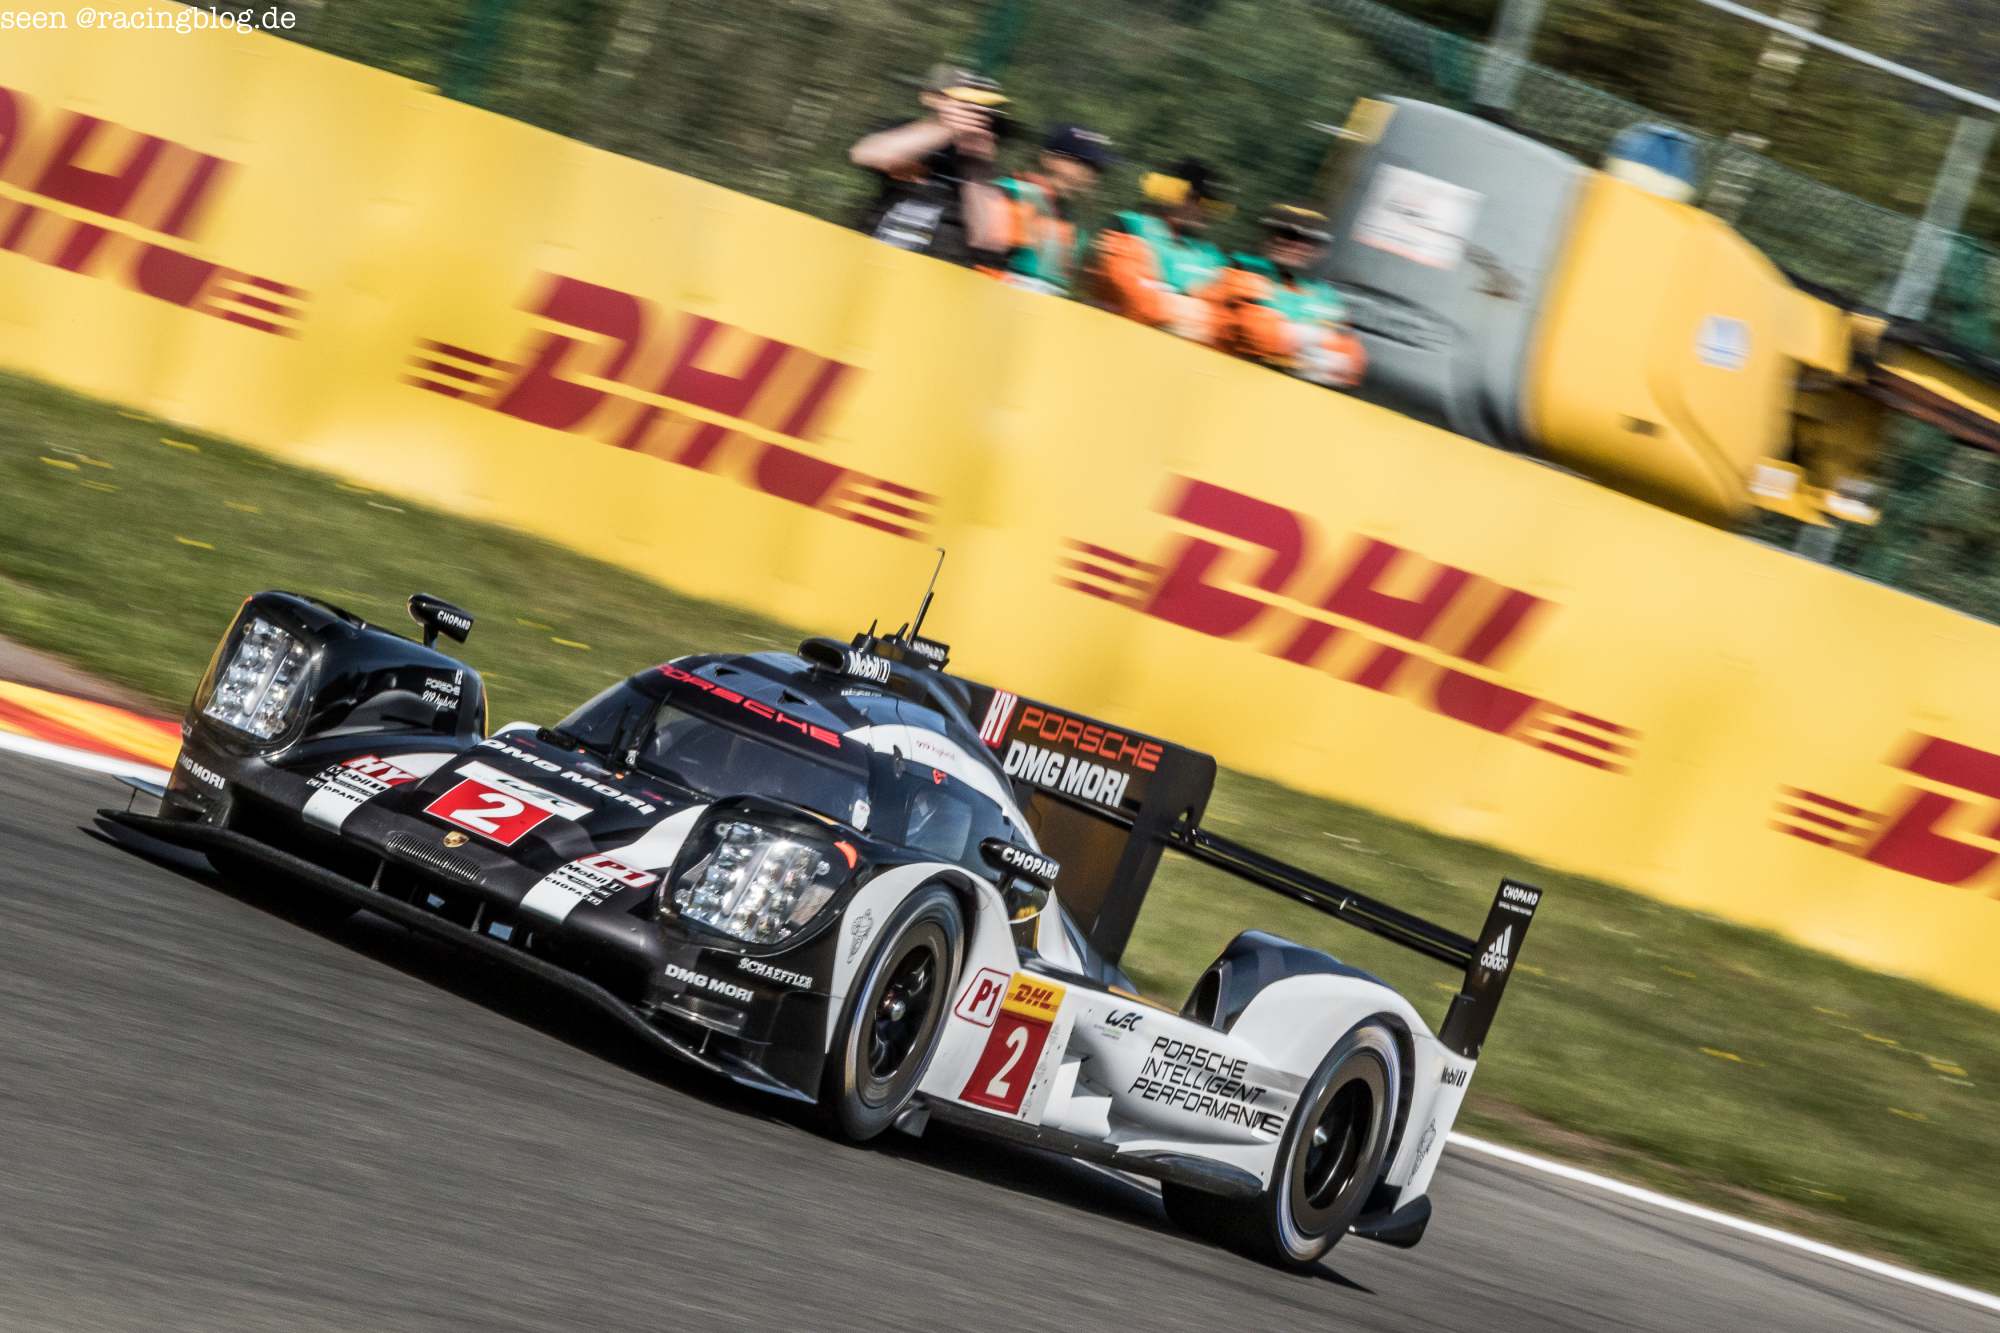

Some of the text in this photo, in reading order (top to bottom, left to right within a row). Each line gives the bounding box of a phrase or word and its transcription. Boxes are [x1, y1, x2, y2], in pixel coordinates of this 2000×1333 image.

[492, 270, 872, 510] DHL
[437, 610, 471, 631] CHOPARD
[1143, 472, 1572, 738] DHL
[848, 650, 880, 680] Mobil
[657, 664, 841, 748] PORSCHE
[979, 689, 1018, 745] HY
[1018, 705, 1164, 772] PORSCHE
[191, 762, 226, 790] MORI
[345, 755, 412, 788] HY
[480, 738, 657, 816] DMG MORI
[1003, 738, 1065, 787] DMG
[1058, 756, 1130, 808] MORI
[449, 792, 526, 834] 2
[564, 864, 607, 885] Mobil
[592, 860, 648, 882] P1
[1001, 847, 1060, 880] CHOPARD
[1503, 884, 1539, 906] CHOPARD
[738, 957, 814, 989] SCHAEFFLER
[1480, 952, 1509, 972] adidas
[665, 963, 756, 1003] DMG MORI
[968, 979, 1002, 1018] P1
[1012, 983, 1056, 1010] DHL
[1105, 1009, 1143, 1032] WEC
[985, 1026, 1029, 1098] 2
[1150, 1036, 1248, 1079] PORSCHE
[1142, 1057, 1267, 1104] INTELLIGENT
